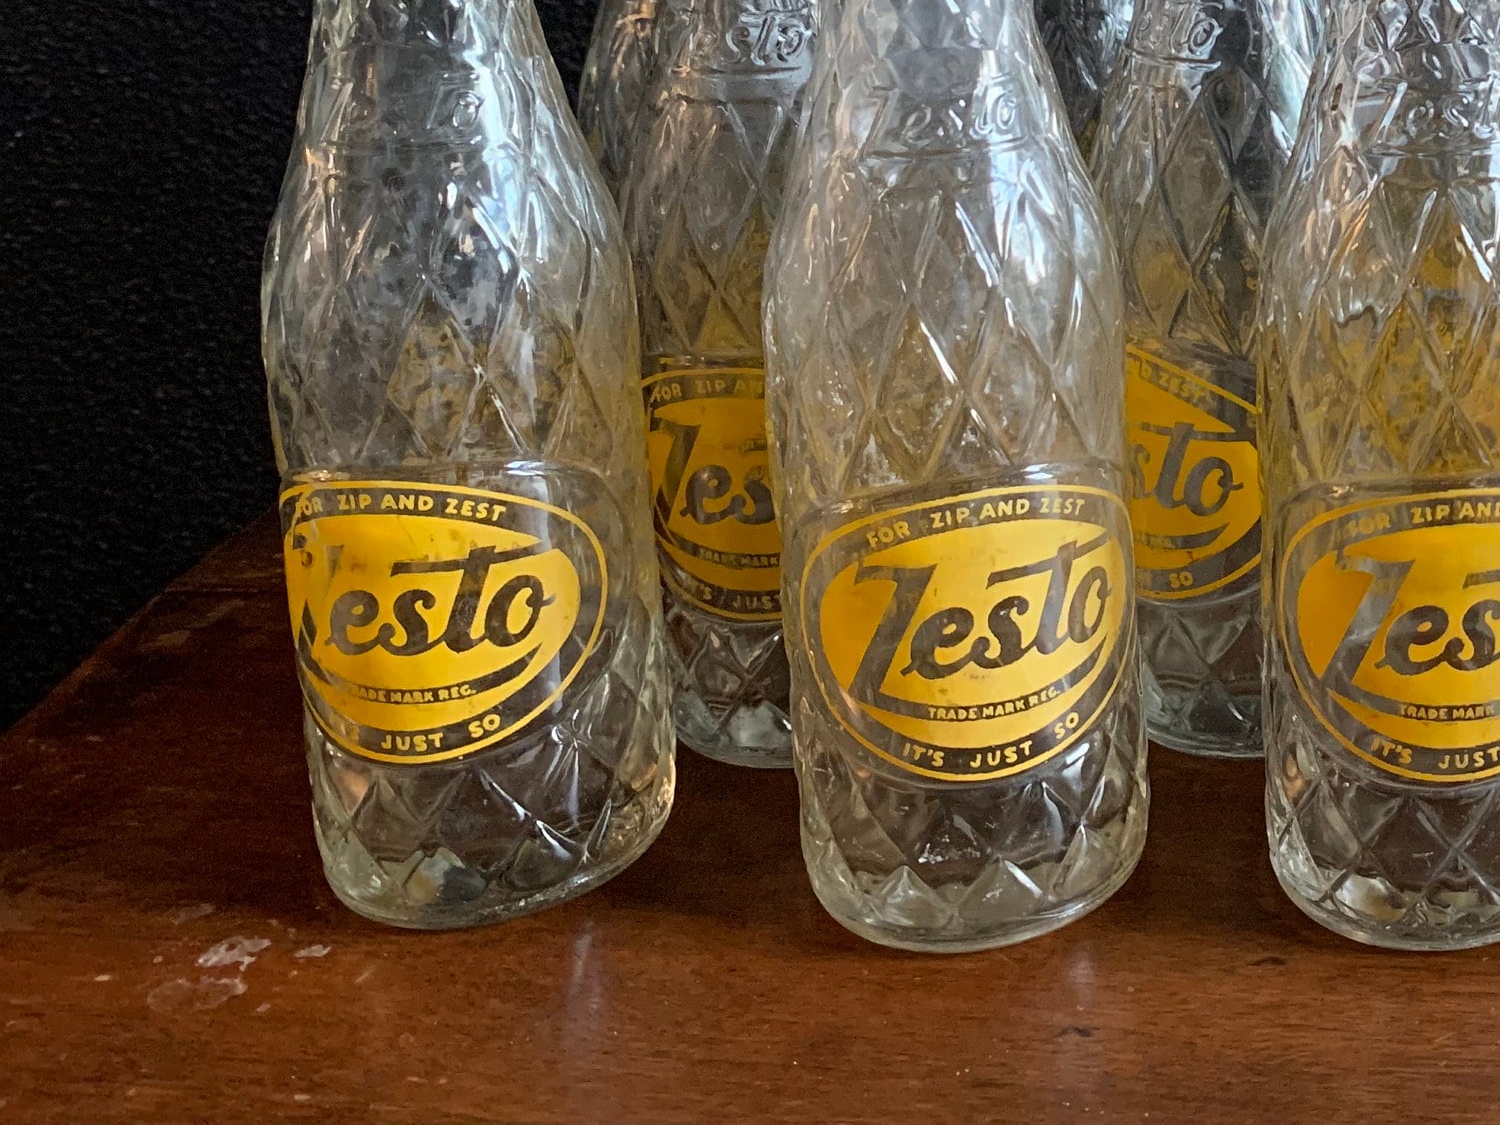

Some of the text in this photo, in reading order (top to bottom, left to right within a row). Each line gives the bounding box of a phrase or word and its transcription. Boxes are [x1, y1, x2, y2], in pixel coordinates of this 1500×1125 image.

[336, 493, 372, 510] ZIP
[381, 493, 433, 512] AND
[444, 497, 507, 522] ZEST
[1410, 505, 1452, 525] ZIP
[866, 498, 1086, 549] FOR ZIP AND ZEST
[848, 538, 1112, 695] Zesto
[390, 689, 434, 704] MARK
[437, 683, 476, 702] REG.
[927, 705, 979, 722] TRADE
[982, 696, 1025, 719] MARK
[1400, 705, 1448, 720] TRADE
[380, 713, 501, 753] JUST SO
[901, 711, 1080, 769] IT'S JUST SO
[1370, 737, 1414, 765] IT'S
[1438, 746, 1500, 770] JUST
